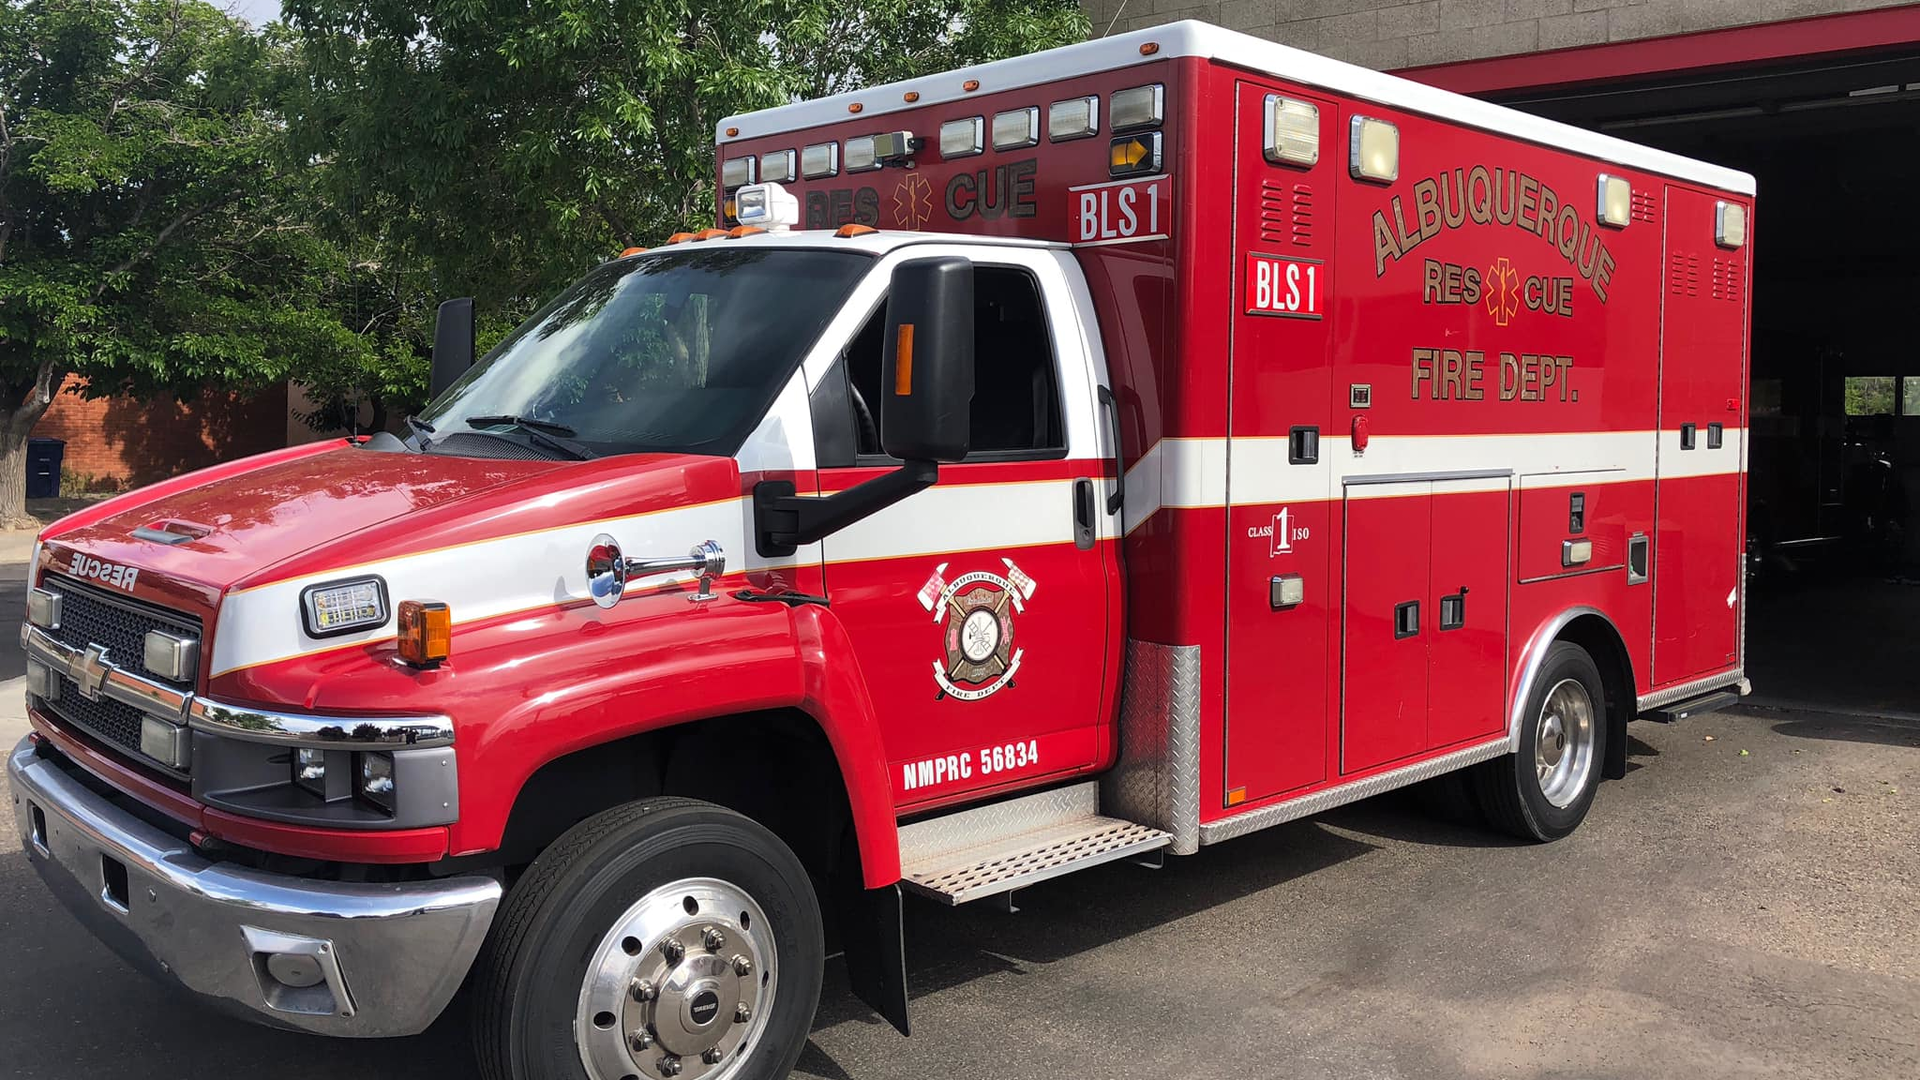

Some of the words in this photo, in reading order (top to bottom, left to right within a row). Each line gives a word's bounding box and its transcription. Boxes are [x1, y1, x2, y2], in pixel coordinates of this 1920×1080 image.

[806, 187, 879, 230] RES
[945, 158, 1037, 221] CUE
[1081, 187, 1137, 240] BLS
[1147, 184, 1158, 233] 1
[1372, 165, 1616, 305] ALBUQUERQUE
[1256, 260, 1300, 311] BLS
[1306, 266, 1315, 312] 1
[1424, 258, 1481, 304] RES
[1524, 276, 1573, 317] CUE
[1411, 347, 1485, 401] FIRE
[1500, 353, 1578, 402] DEPT.
[1248, 526, 1273, 538] CLASS
[1276, 506, 1291, 549] 1
[1292, 527, 1310, 540] ISO
[942, 573, 1016, 601] ALBUQUERQUE
[945, 684, 970, 698] FIRE
[903, 753, 972, 790] NMPRC
[980, 740, 1038, 774] 56834
